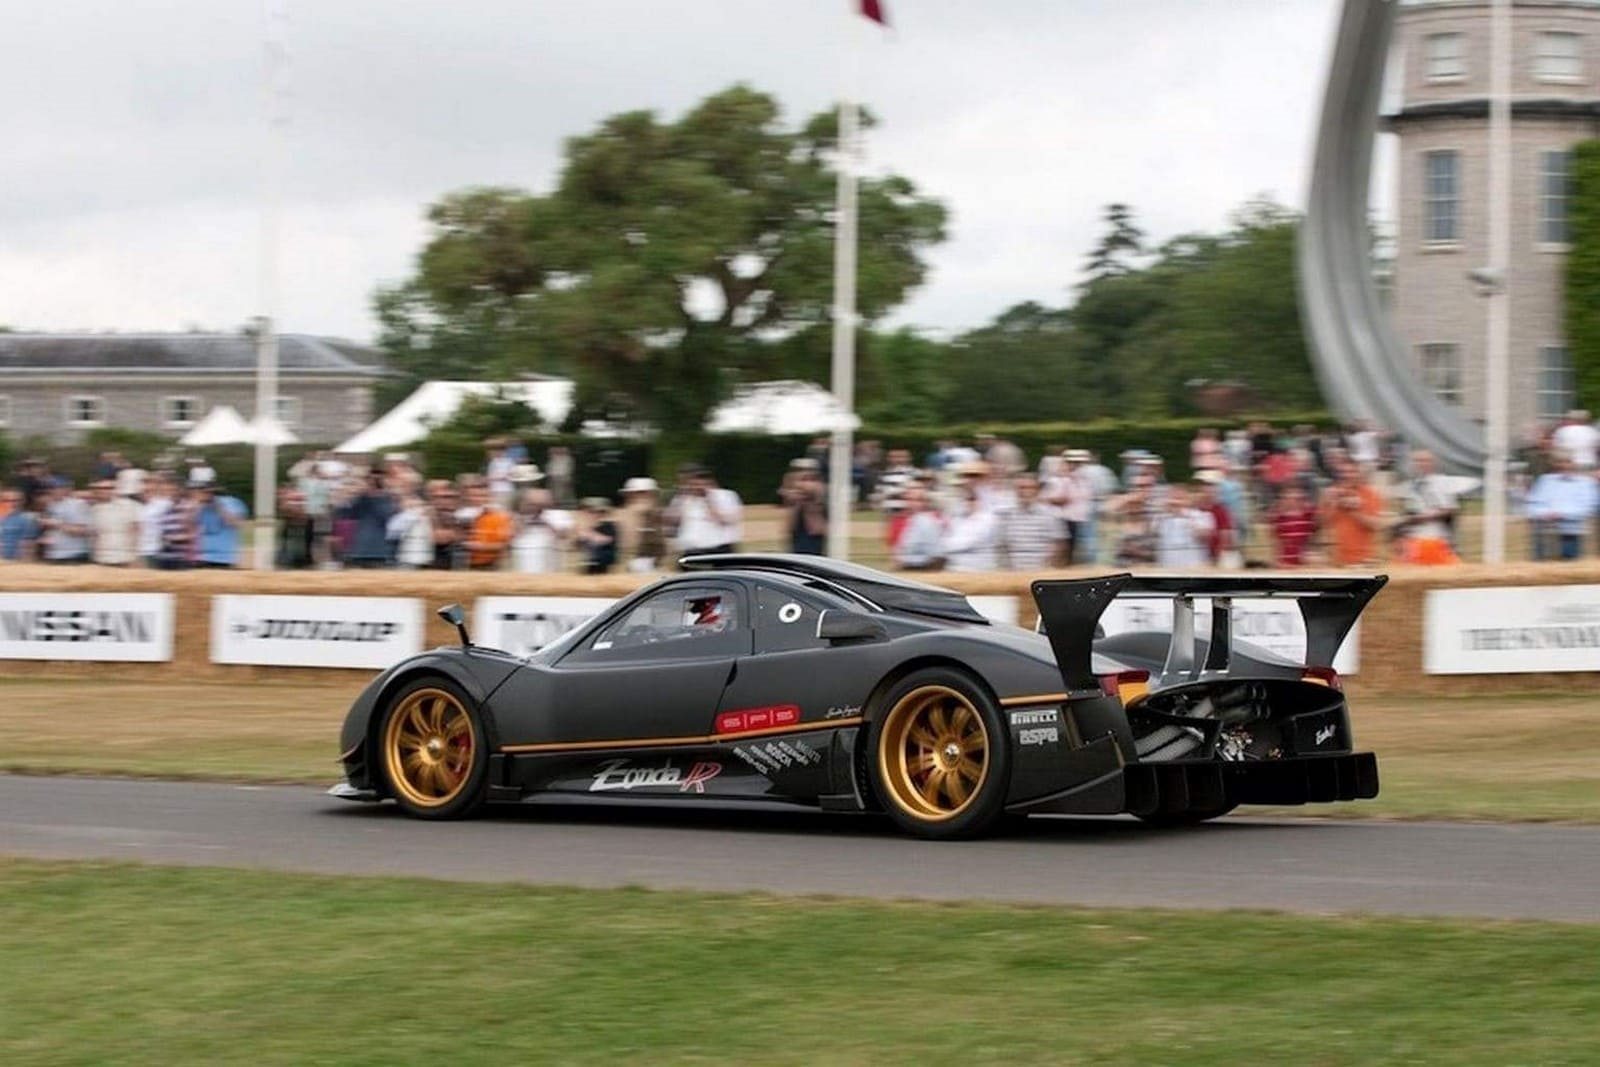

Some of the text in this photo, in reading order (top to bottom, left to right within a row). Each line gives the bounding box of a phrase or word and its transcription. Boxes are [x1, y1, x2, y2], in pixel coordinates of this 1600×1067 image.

[1010, 710, 1057, 725] PIRELLI
[589, 759, 722, 793] Zonda R
